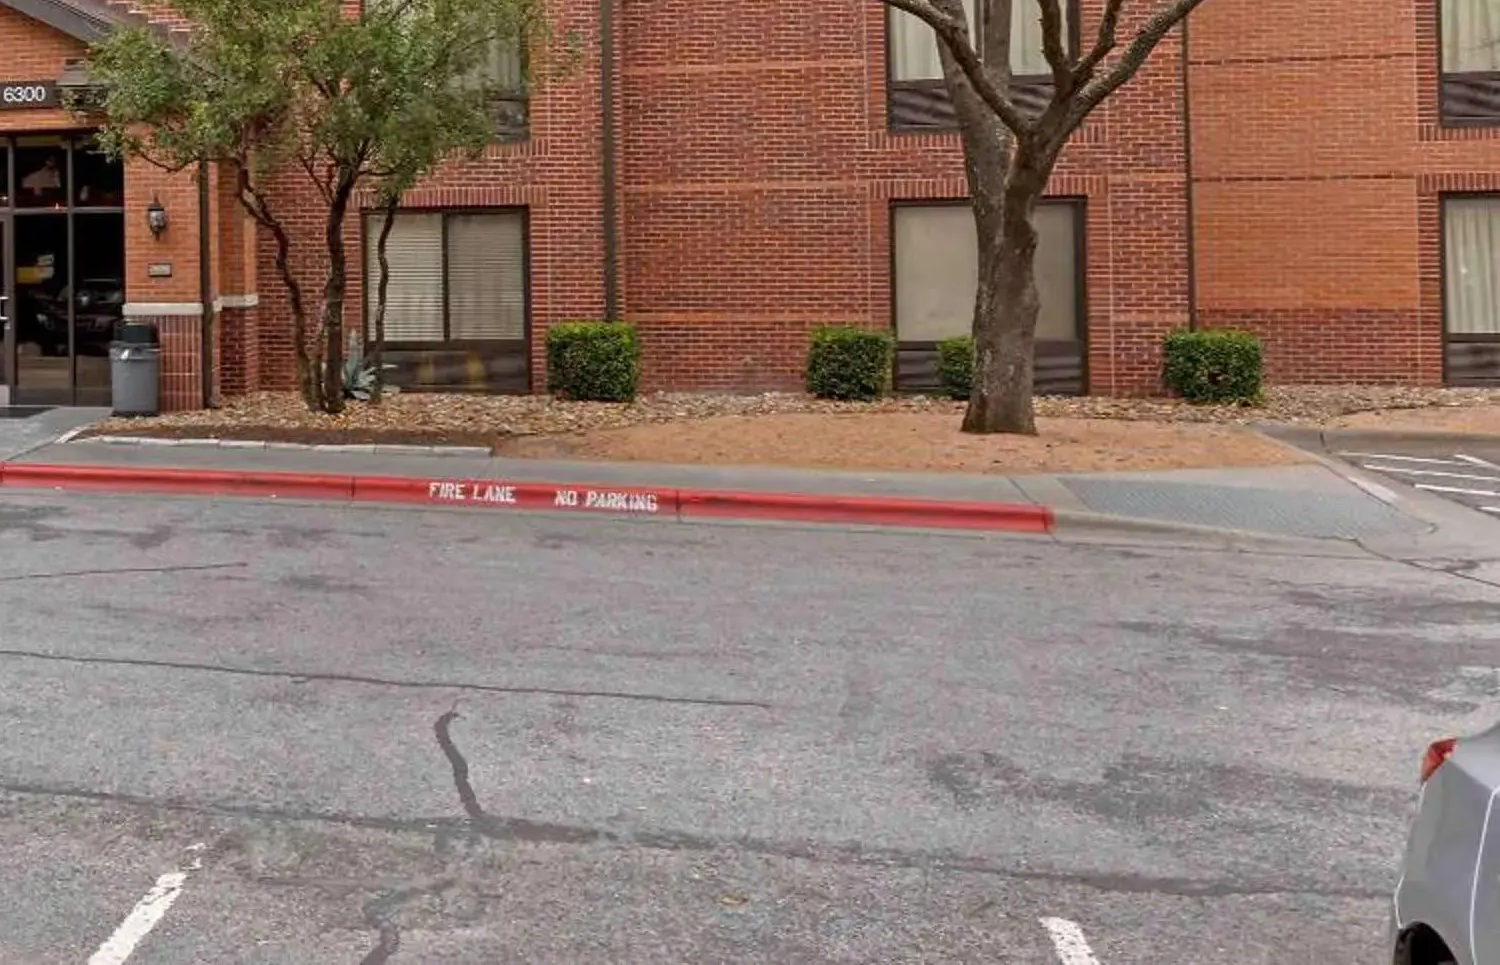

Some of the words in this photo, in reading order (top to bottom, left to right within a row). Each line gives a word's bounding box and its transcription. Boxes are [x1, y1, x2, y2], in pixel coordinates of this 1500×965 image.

[3, 86, 46, 102] 6300
[429, 483, 465, 499] FIRE
[473, 485, 516, 503] LANE
[555, 490, 577, 506] NO
[586, 491, 658, 511] PARKING
